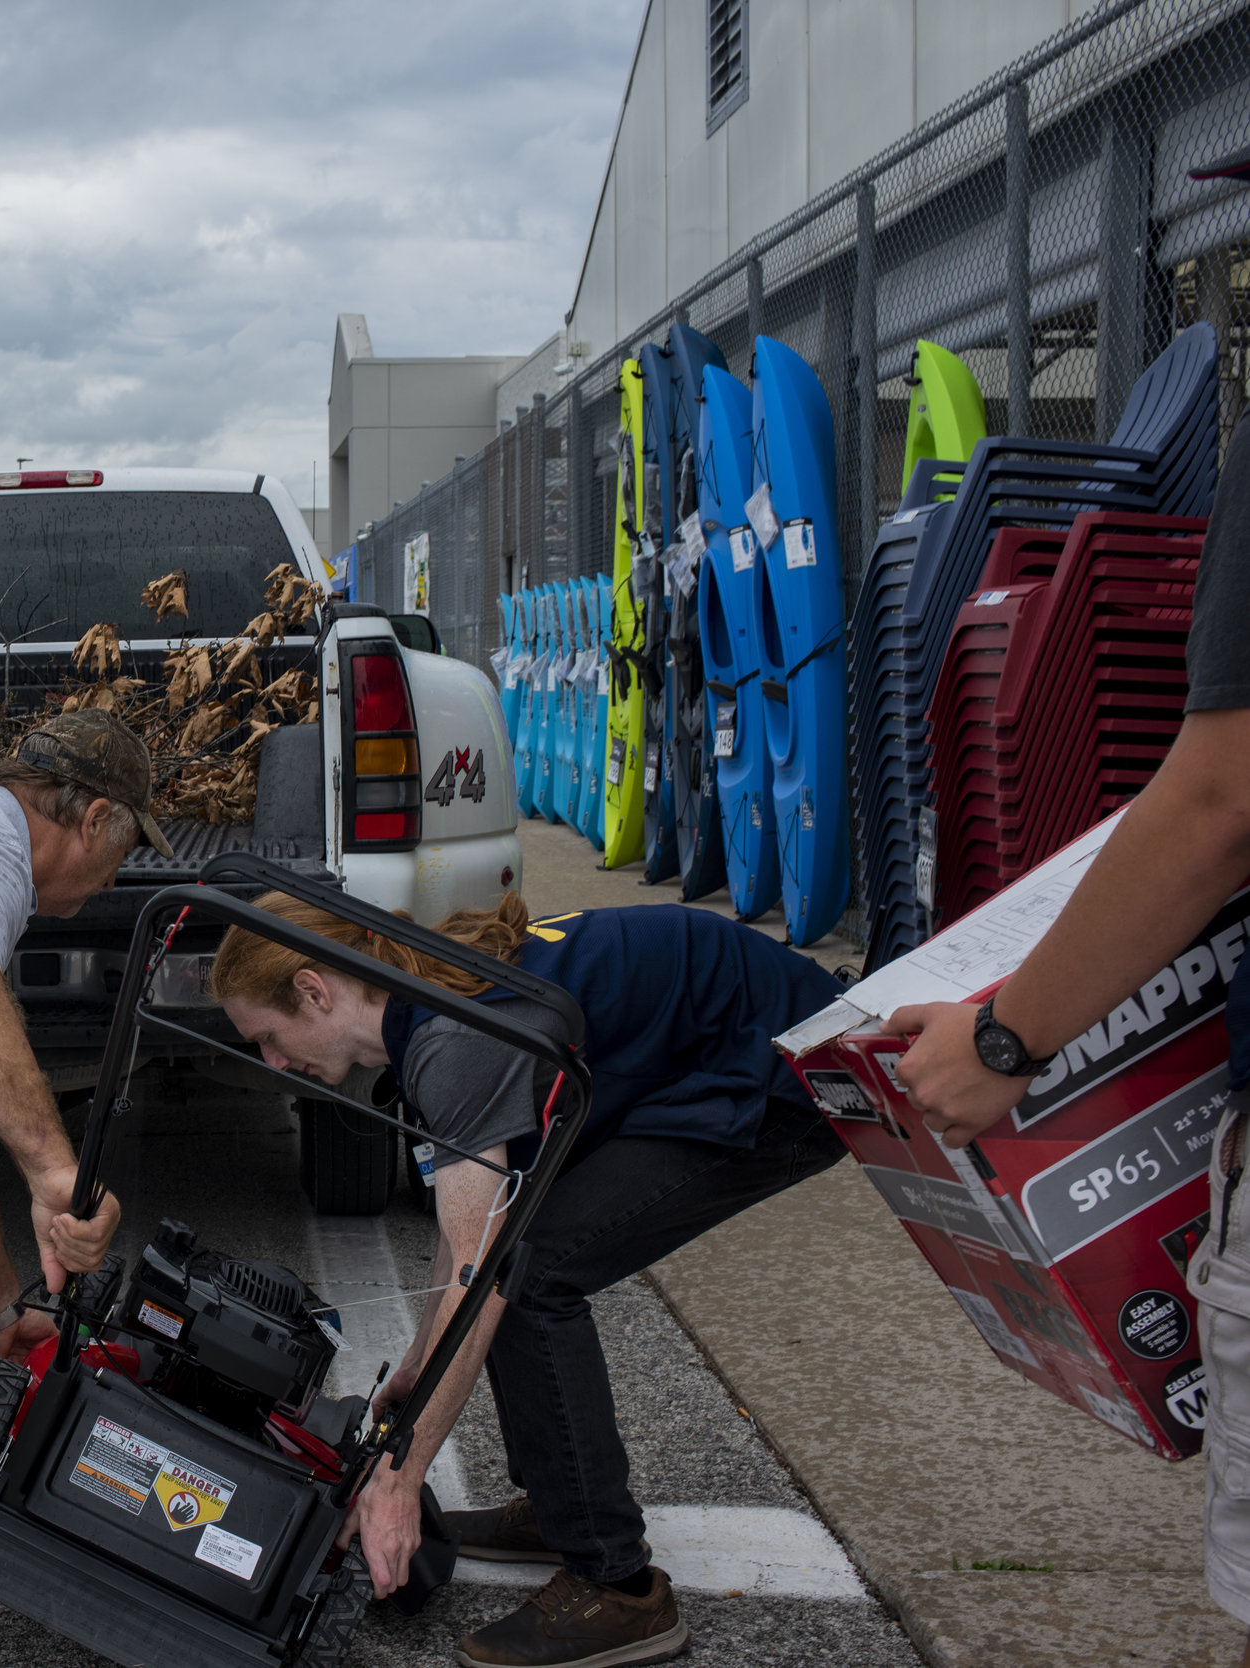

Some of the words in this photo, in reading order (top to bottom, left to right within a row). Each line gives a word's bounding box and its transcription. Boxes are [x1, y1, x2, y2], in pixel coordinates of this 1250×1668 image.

[1026, 916, 1250, 1096] SNAPPE
[1069, 1149, 1161, 1212] SP65
[1173, 1108, 1196, 1132] 21"
[1198, 1089, 1232, 1120] 3-N-
[1125, 1300, 1176, 1338] ASSEMBLY
[1129, 1297, 1157, 1320] EASY
[1165, 1373, 1192, 1395] EASY
[1175, 1386, 1210, 1424] M
[104, 1421, 131, 1438] DANGER
[99, 1475, 131, 1494] WARNING
[162, 1473, 175, 1483] KEEP
[175, 1479, 190, 1491] HANDS
[198, 1491, 210, 1501] FEET
[210, 1496, 224, 1508] AWAY
[171, 1467, 221, 1498] DANGER
